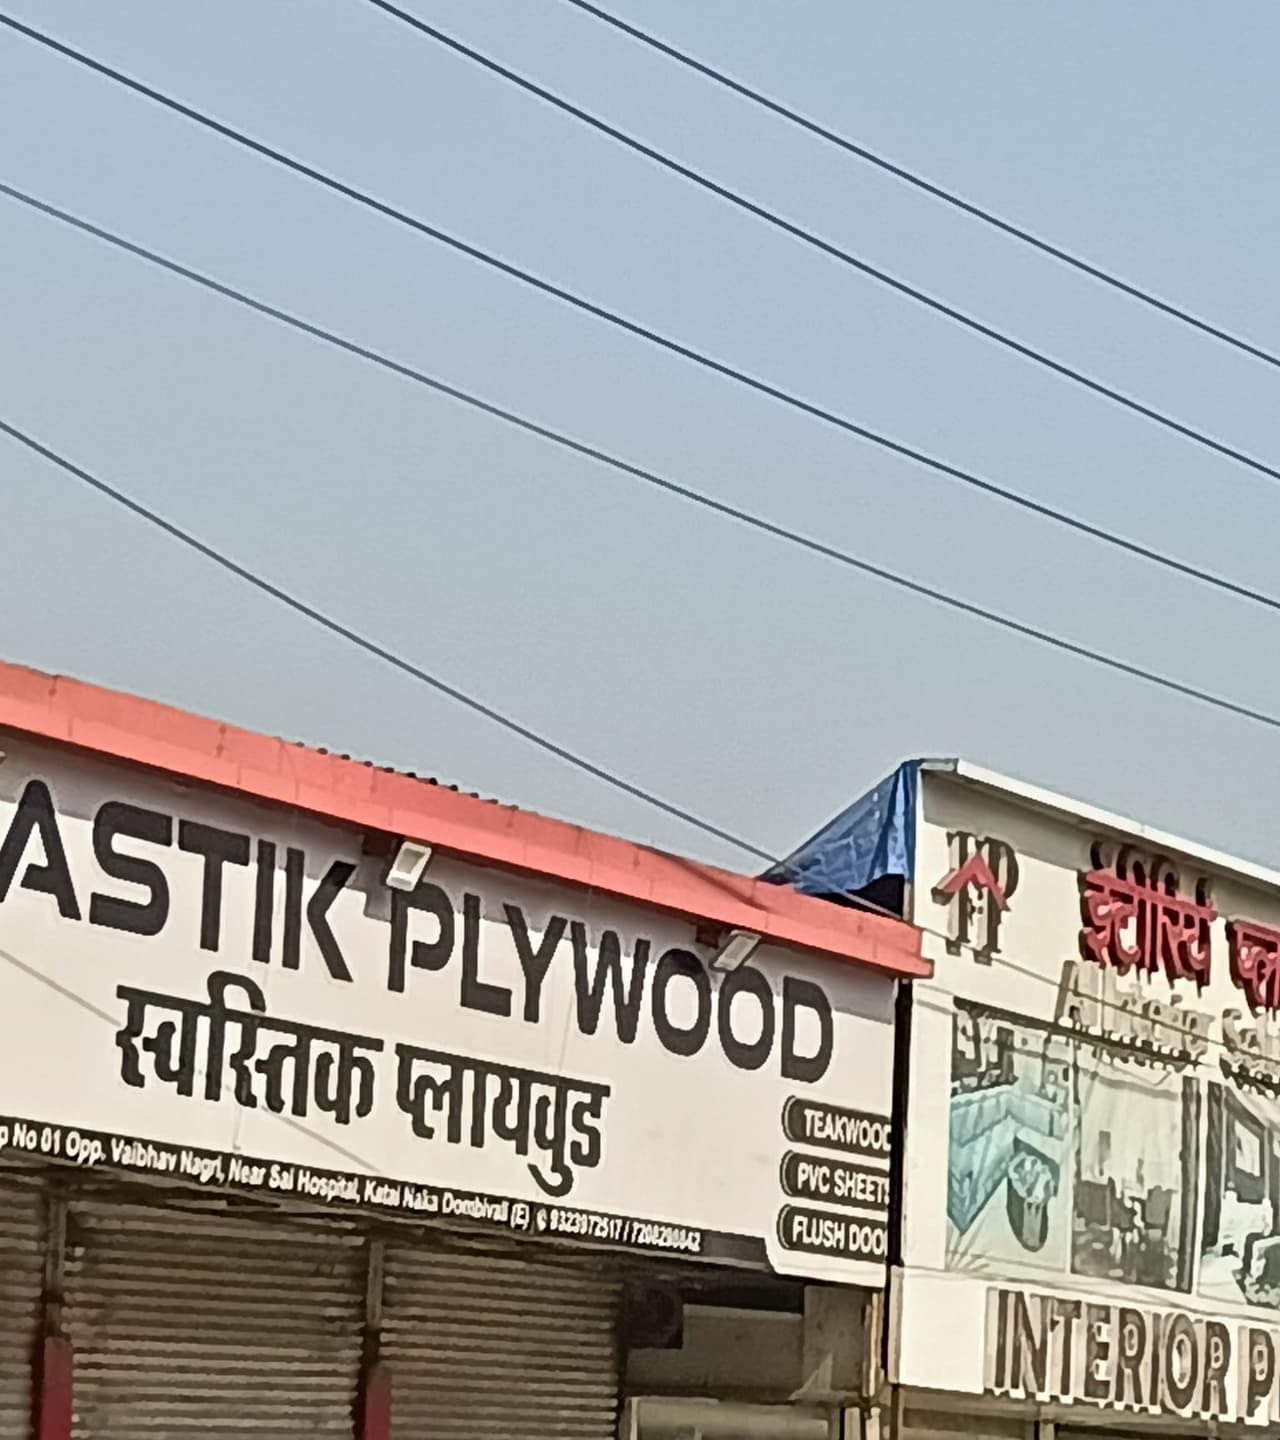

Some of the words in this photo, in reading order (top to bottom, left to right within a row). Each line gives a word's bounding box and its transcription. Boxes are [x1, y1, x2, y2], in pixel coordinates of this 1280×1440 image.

[0, 778, 357, 983] ASTIK
[386, 878, 834, 1084] PLYWOOD
[116, 970, 385, 1125] स्वस्तिक
[396, 1042, 612, 1198] प्लायवुड
[12, 1122, 38, 1151] No
[41, 1127, 61, 1155] 01
[110, 1137, 177, 1171] Vaibhav
[228, 1158, 267, 1185] Near
[269, 1164, 295, 1191] Sai
[510, 1203, 531, 1231] (E)
[792, 1214, 846, 1250] FLUSH
[797, 1161, 831, 1194] PVC
[990, 1285, 1231, 1415] INTERIOR
